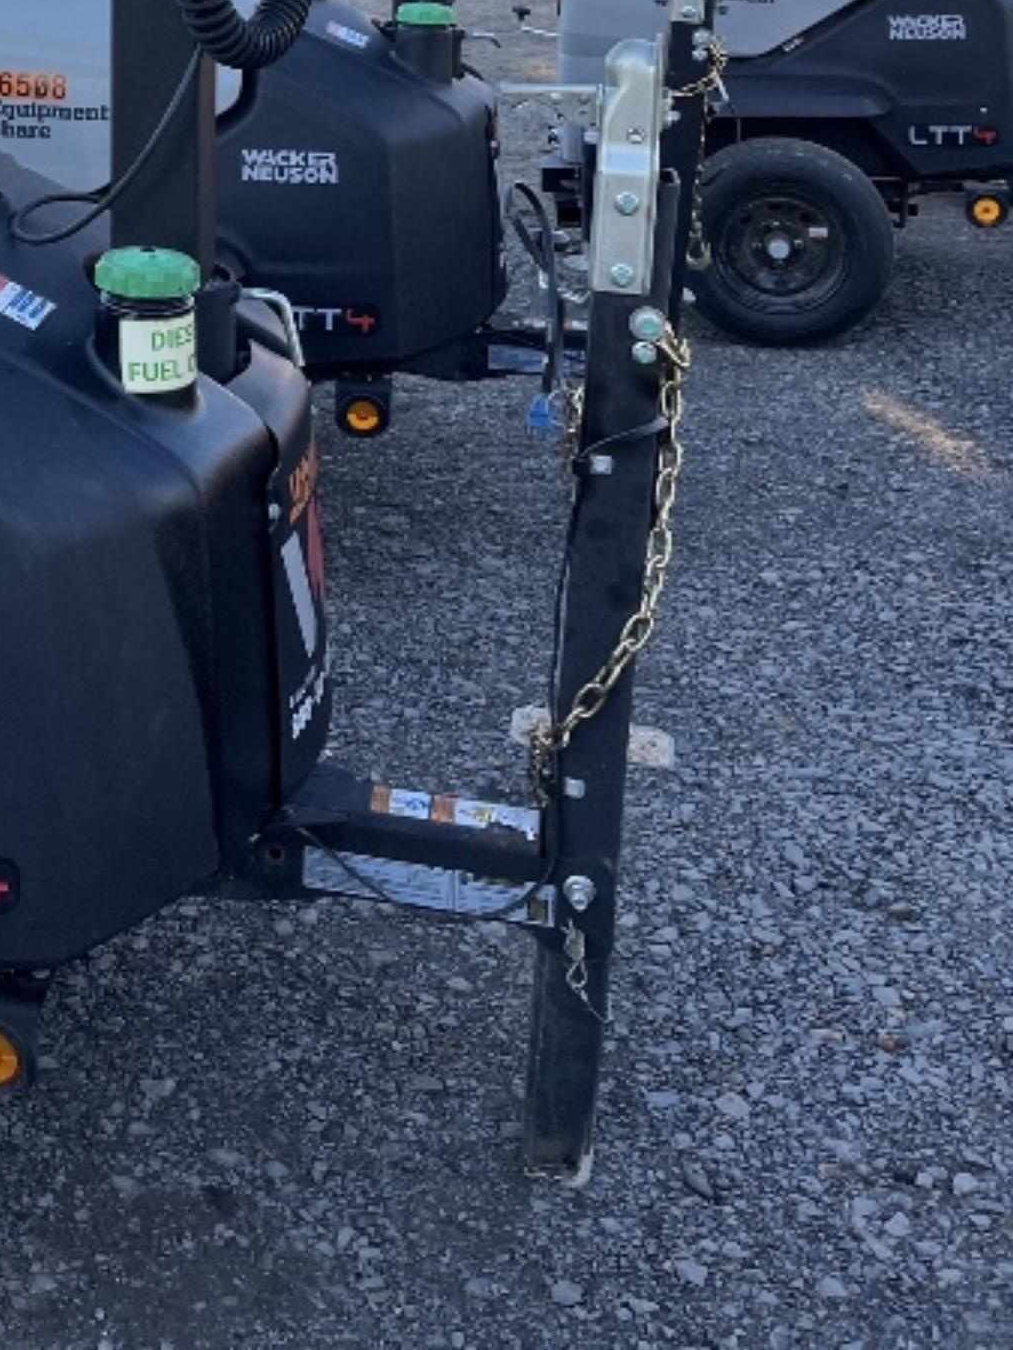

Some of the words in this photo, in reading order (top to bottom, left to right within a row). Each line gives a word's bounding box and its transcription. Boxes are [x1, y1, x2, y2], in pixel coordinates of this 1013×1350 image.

[909, 124, 996, 145] LTT4
[241, 149, 336, 167] WACKER
[241, 164, 339, 184] NEUSON
[291, 305, 376, 334] TT4
[151, 322, 193, 351] DIES
[128, 359, 183, 382] FUEL
